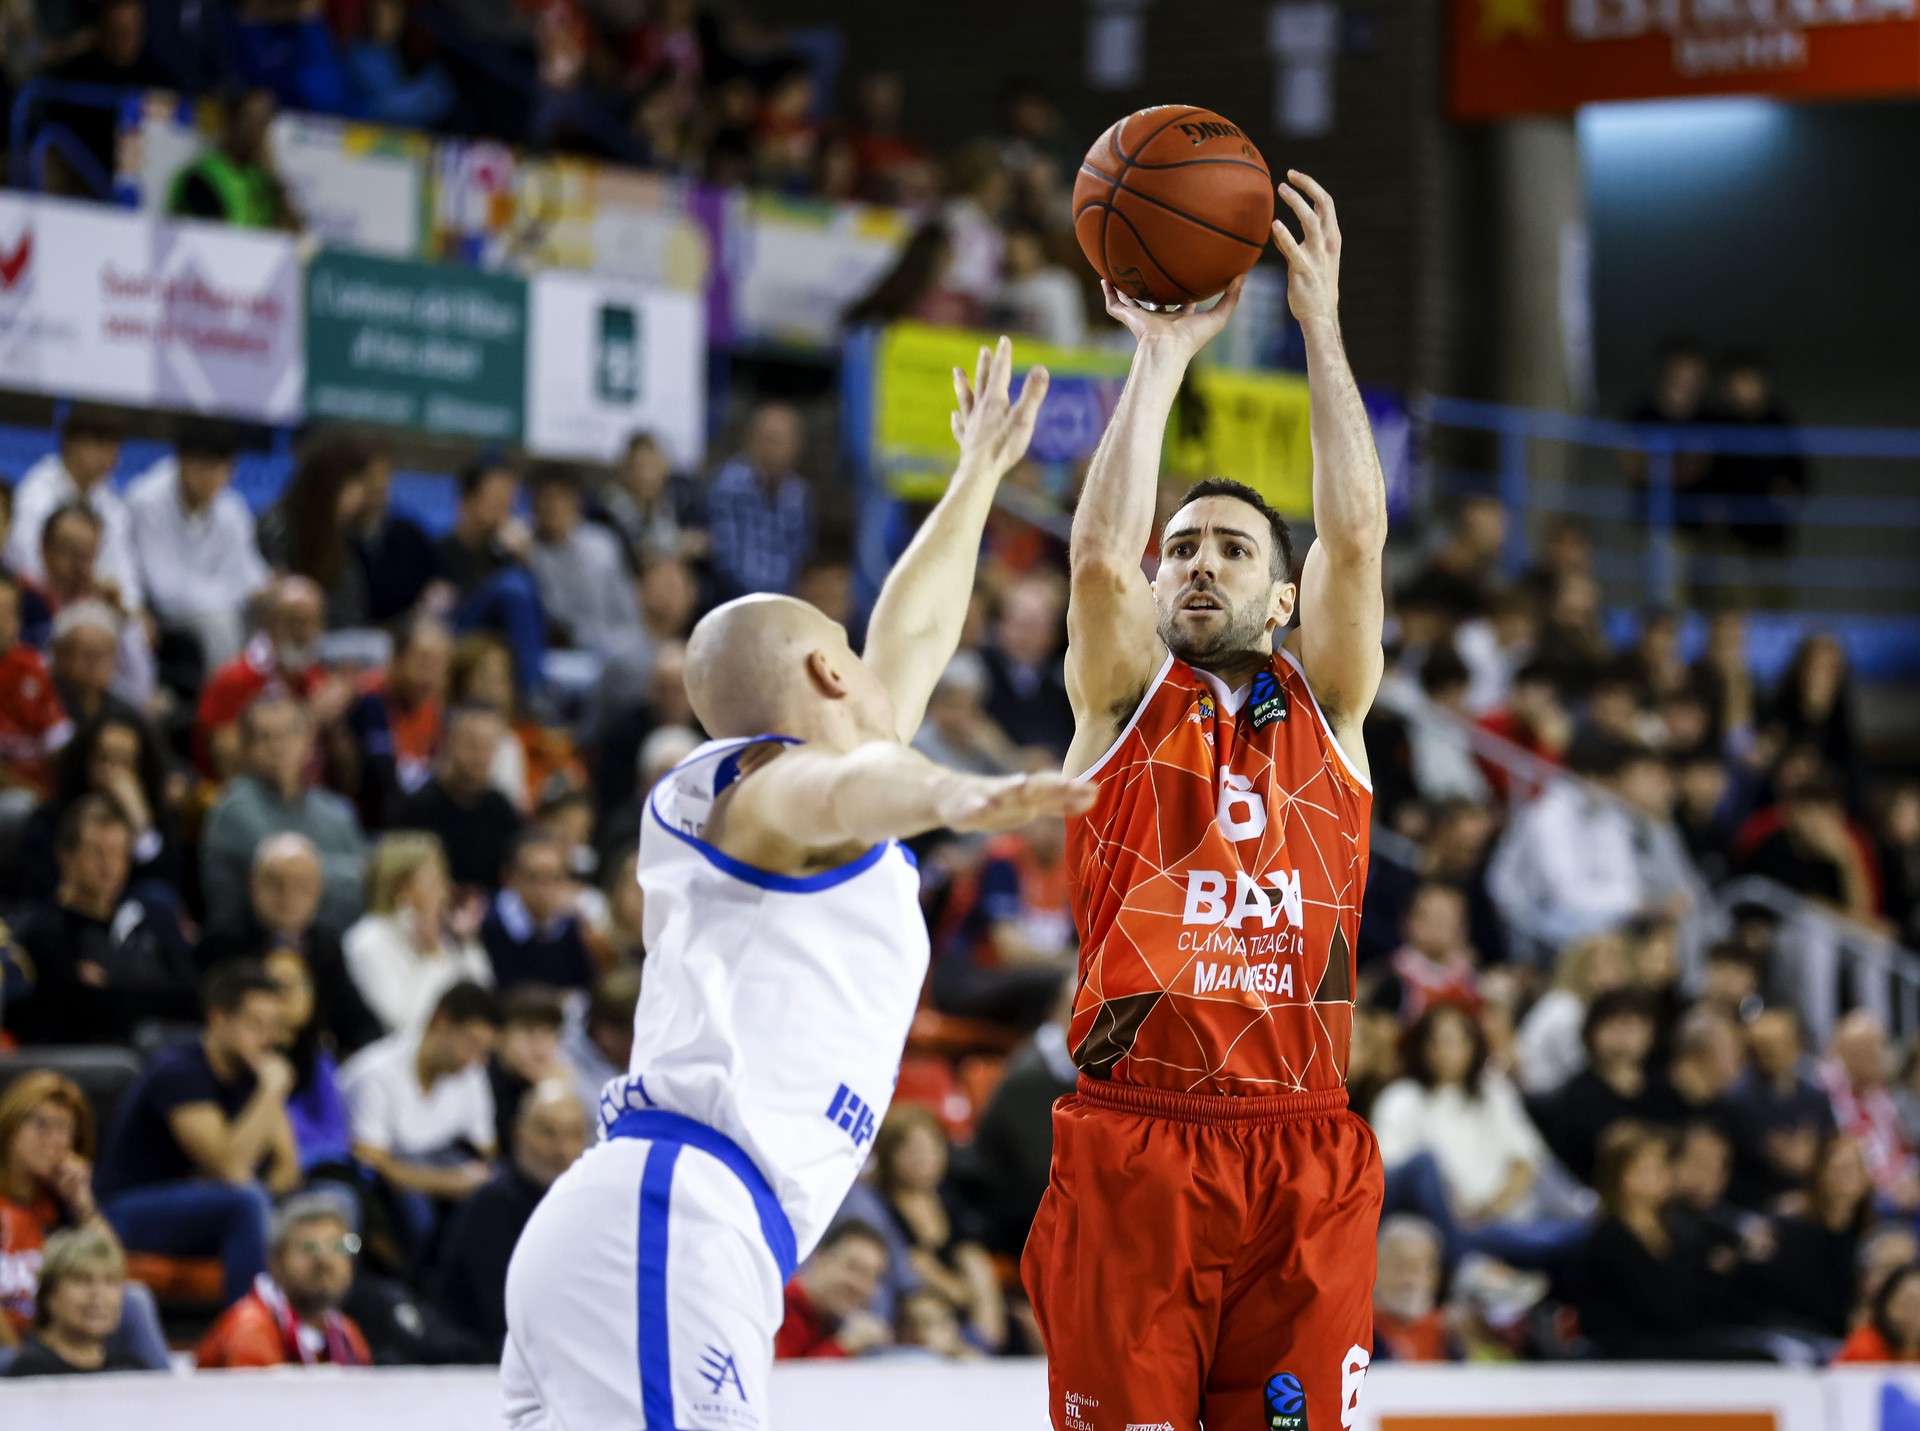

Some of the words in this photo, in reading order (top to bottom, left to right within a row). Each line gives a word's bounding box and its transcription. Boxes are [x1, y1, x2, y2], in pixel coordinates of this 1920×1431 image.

[1253, 708, 1287, 728] EuroCup
[1254, 698, 1279, 718] BKT
[1216, 764, 1267, 843] 6
[1341, 1343, 1370, 1431] 6
[1065, 1402, 1082, 1418] ETL
[1272, 1416, 1301, 1427] BKT
